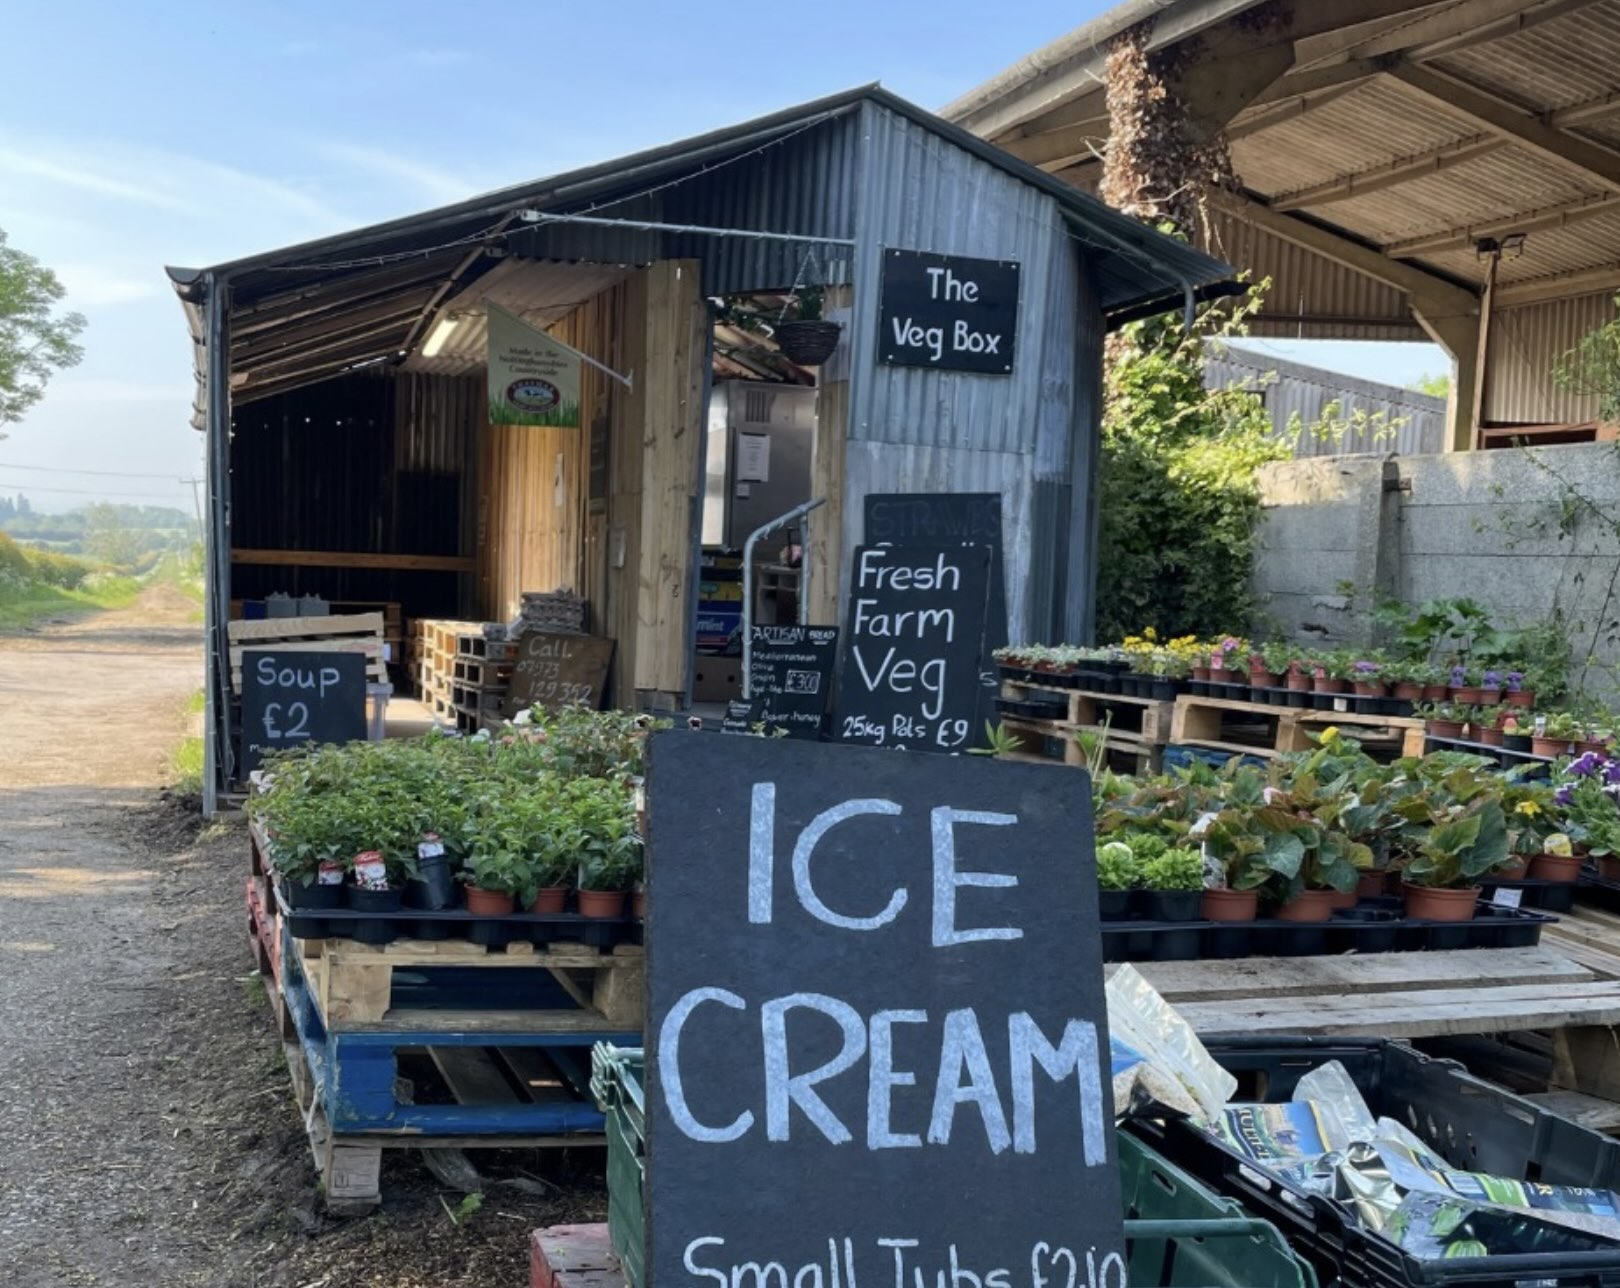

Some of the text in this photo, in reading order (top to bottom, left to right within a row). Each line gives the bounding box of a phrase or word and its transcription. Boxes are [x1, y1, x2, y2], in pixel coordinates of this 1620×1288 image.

[926, 267, 980, 303] The
[892, 316, 1001, 361] Veg Box
[859, 550, 960, 591] Fresh
[751, 626, 805, 641] ARTISAN
[854, 599, 955, 643] Farm
[256, 656, 341, 698] Soup
[852, 645, 946, 720] Veg
[261, 701, 311, 739] £2
[936, 719, 969, 747] £9
[748, 781, 1024, 947] ICE
[658, 986, 1107, 1167] CREAM
[683, 1236, 856, 1288] Small
